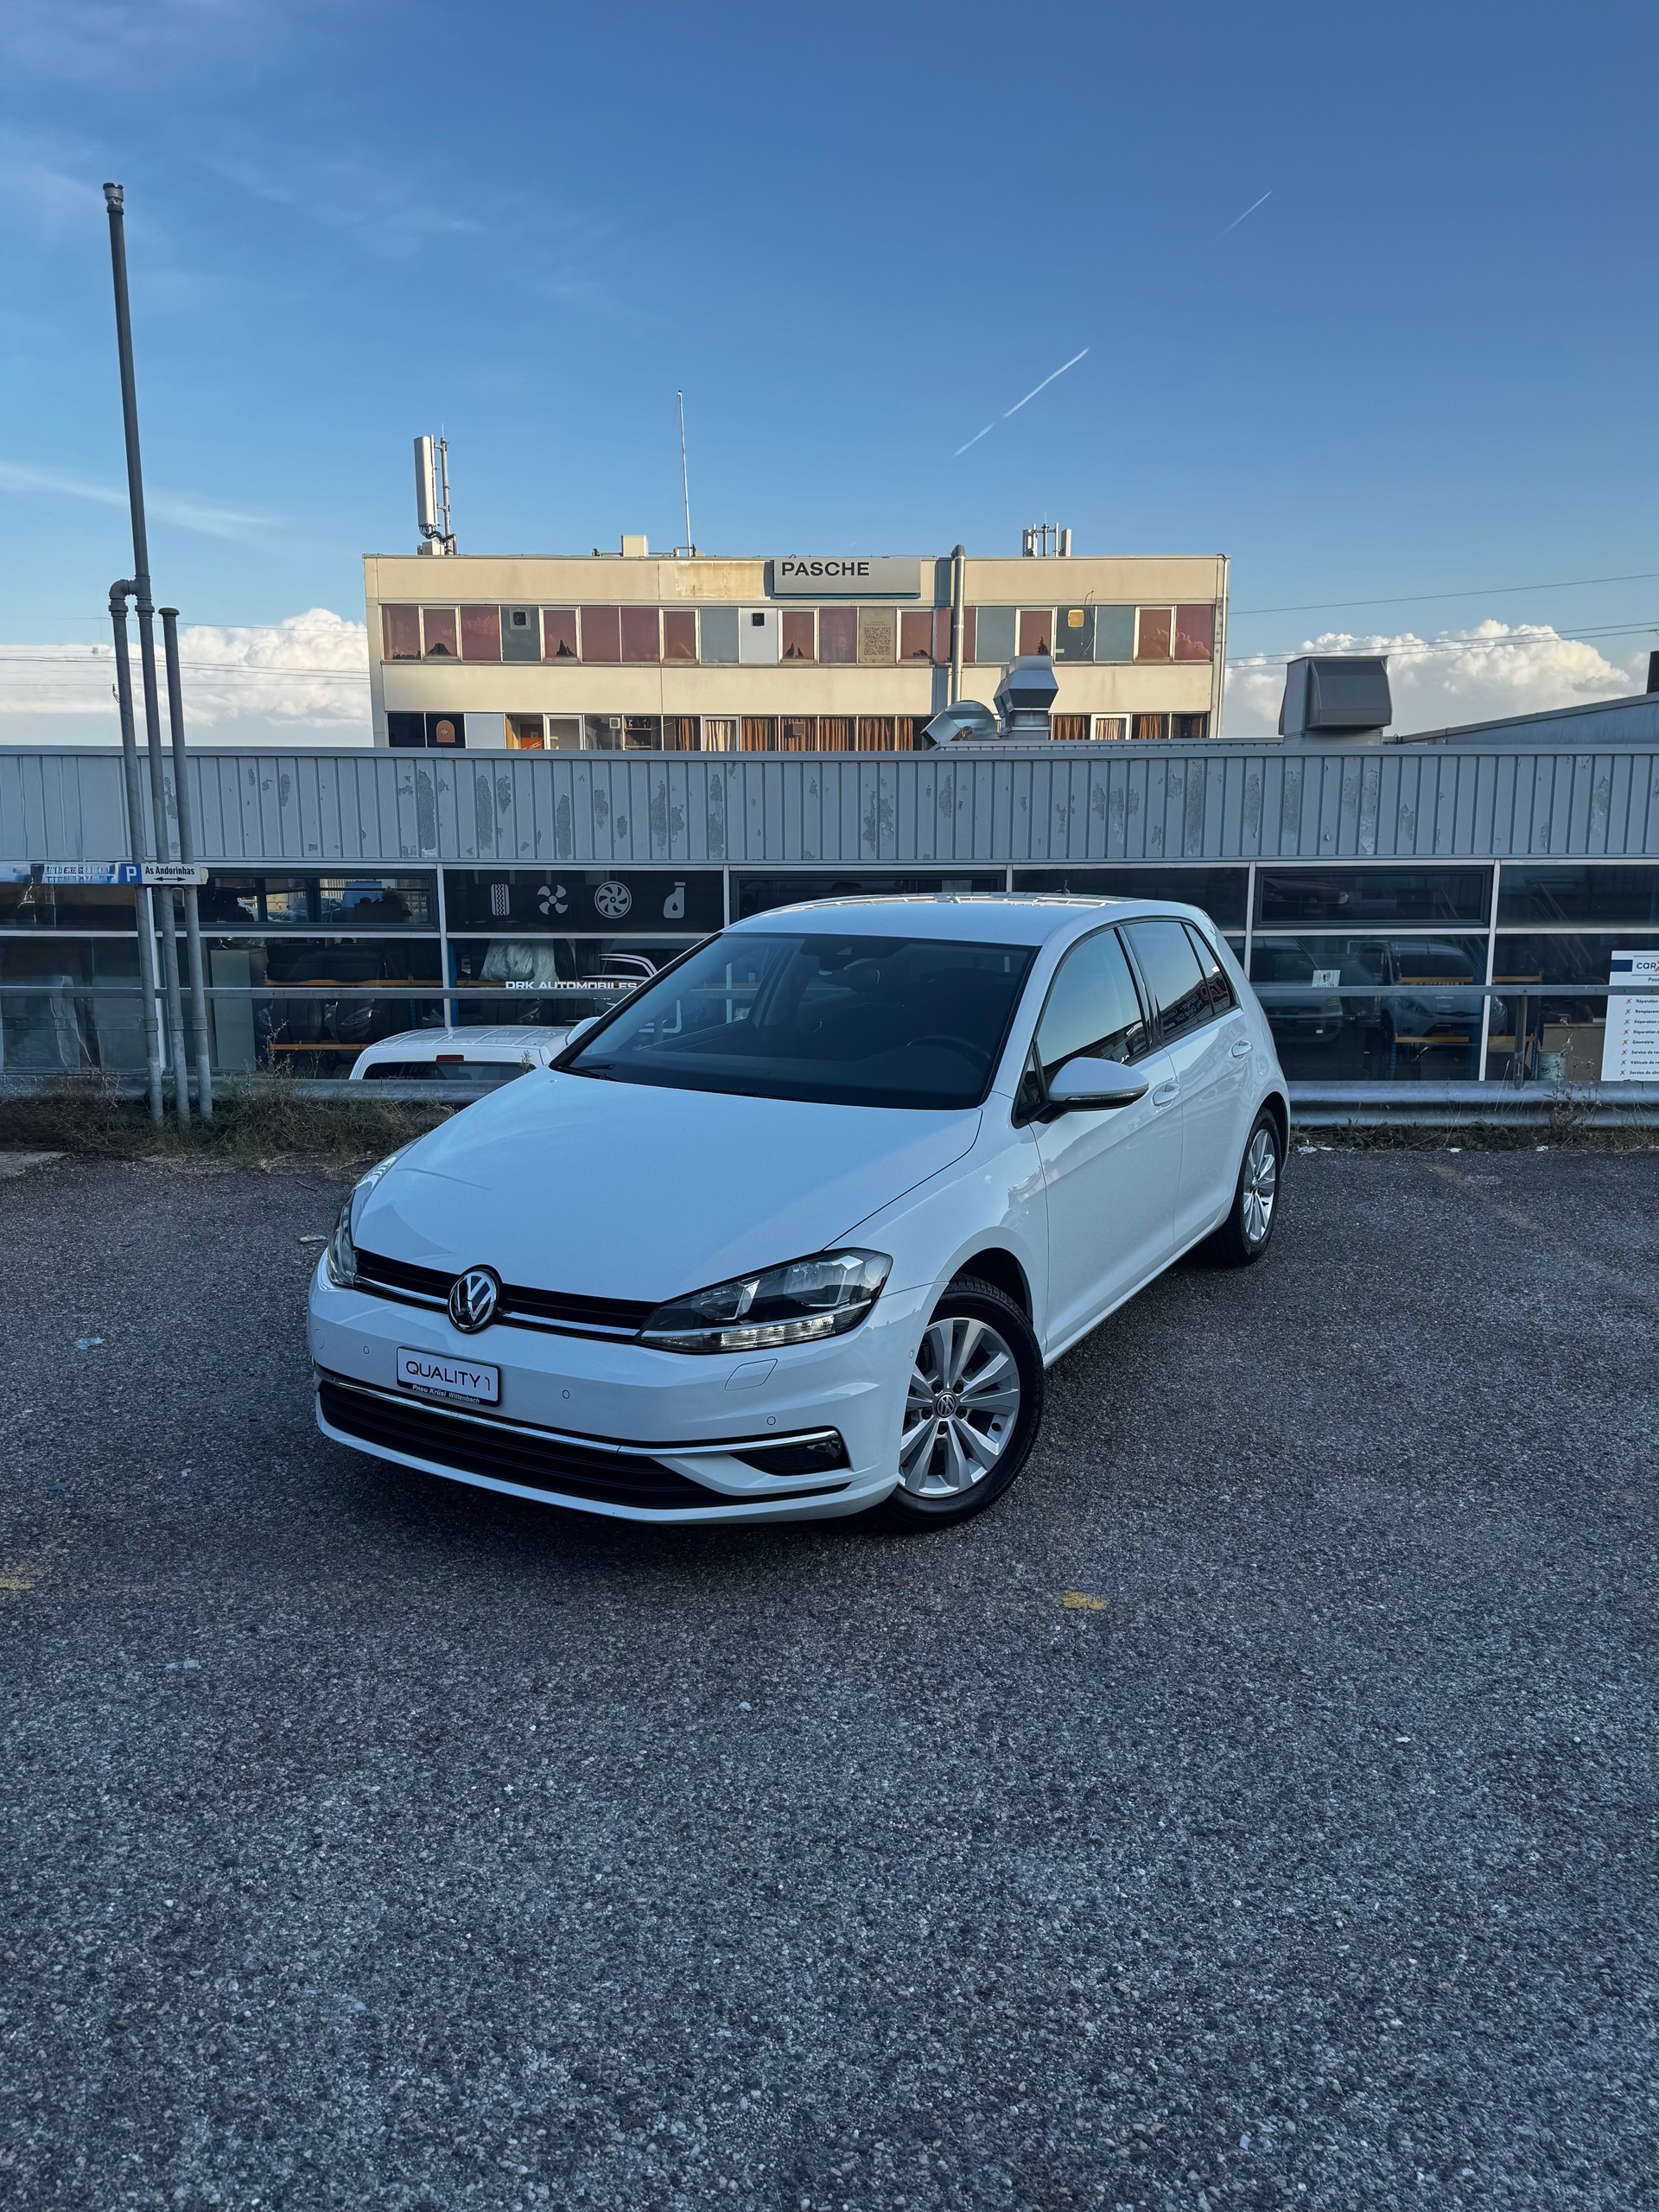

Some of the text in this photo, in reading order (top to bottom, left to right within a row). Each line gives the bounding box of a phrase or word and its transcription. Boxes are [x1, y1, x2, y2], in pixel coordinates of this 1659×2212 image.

[782, 562, 870, 576] PASCHE
[126, 866, 137, 882] P
[145, 866, 195, 875] As Andorinhas
[538, 981, 638, 989] AUTOMOBILES
[405, 1361, 491, 1391] QUALITY 1
[412, 1384, 429, 1393] Pneu
[448, 1392, 480, 1404] Wittenbach
